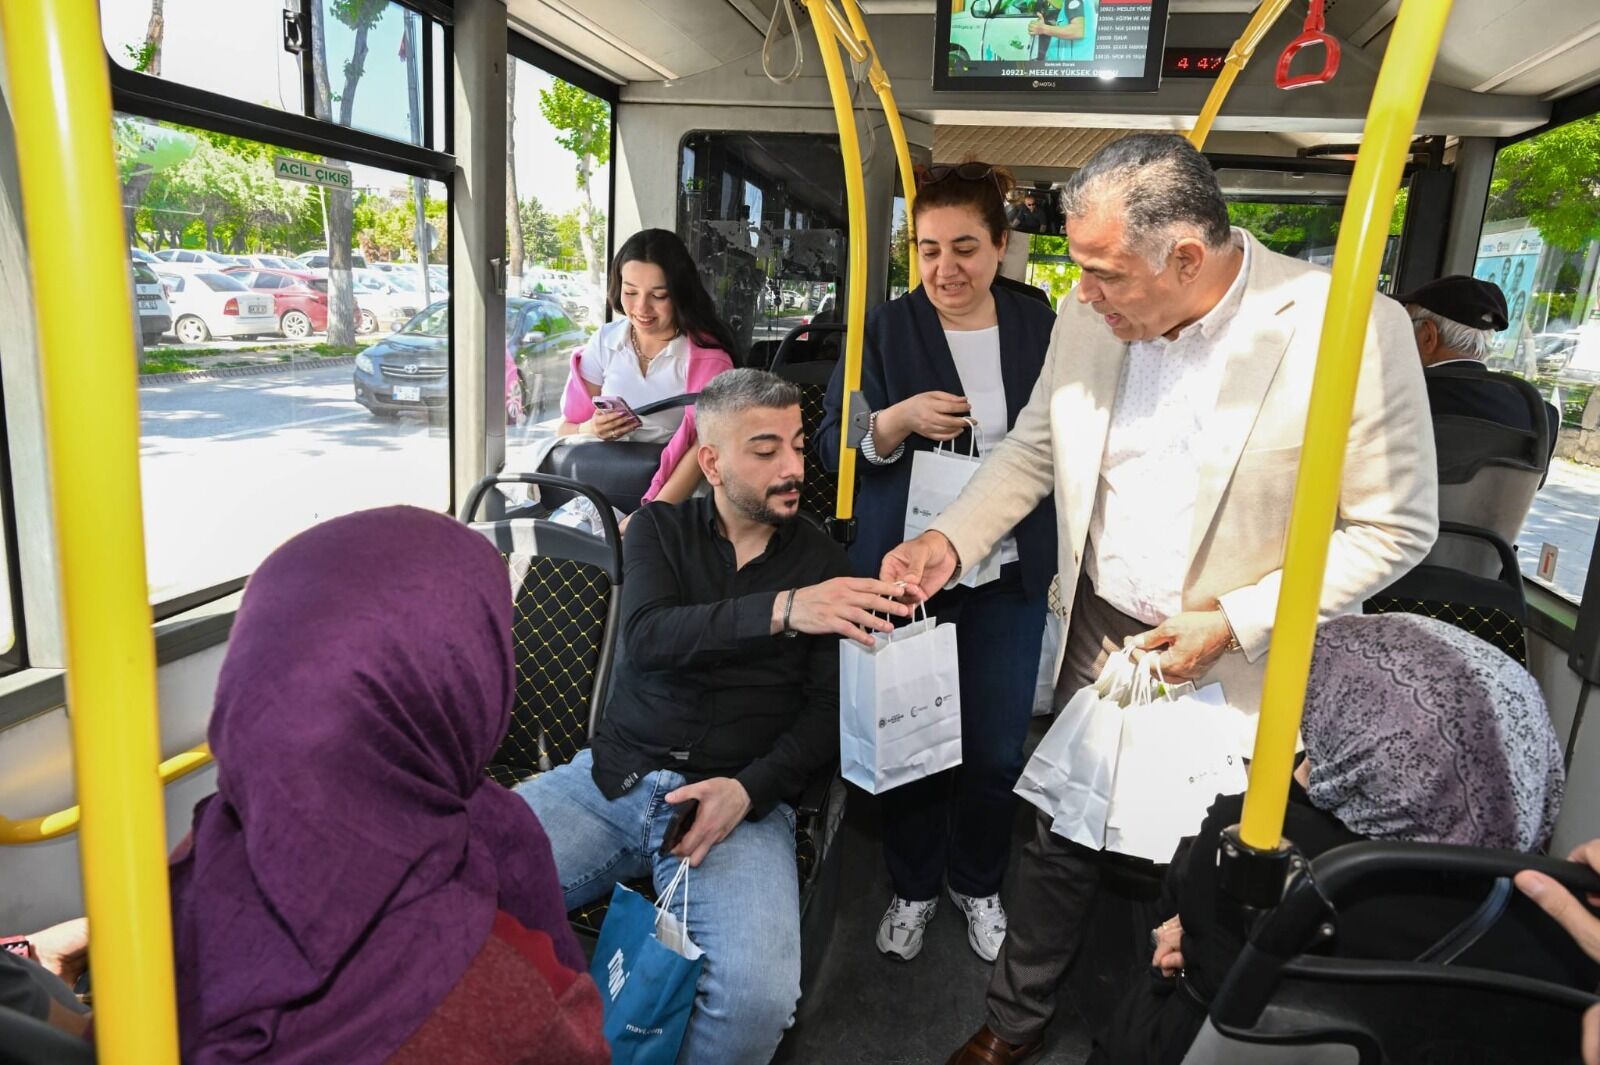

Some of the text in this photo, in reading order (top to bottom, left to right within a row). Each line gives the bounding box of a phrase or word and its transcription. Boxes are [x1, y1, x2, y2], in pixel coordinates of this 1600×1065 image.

[1061, 68, 1090, 76] YÜKSEK
[280, 162, 349, 186] ACİL ÇIKIŞ
[607, 947, 630, 1002] mavi
